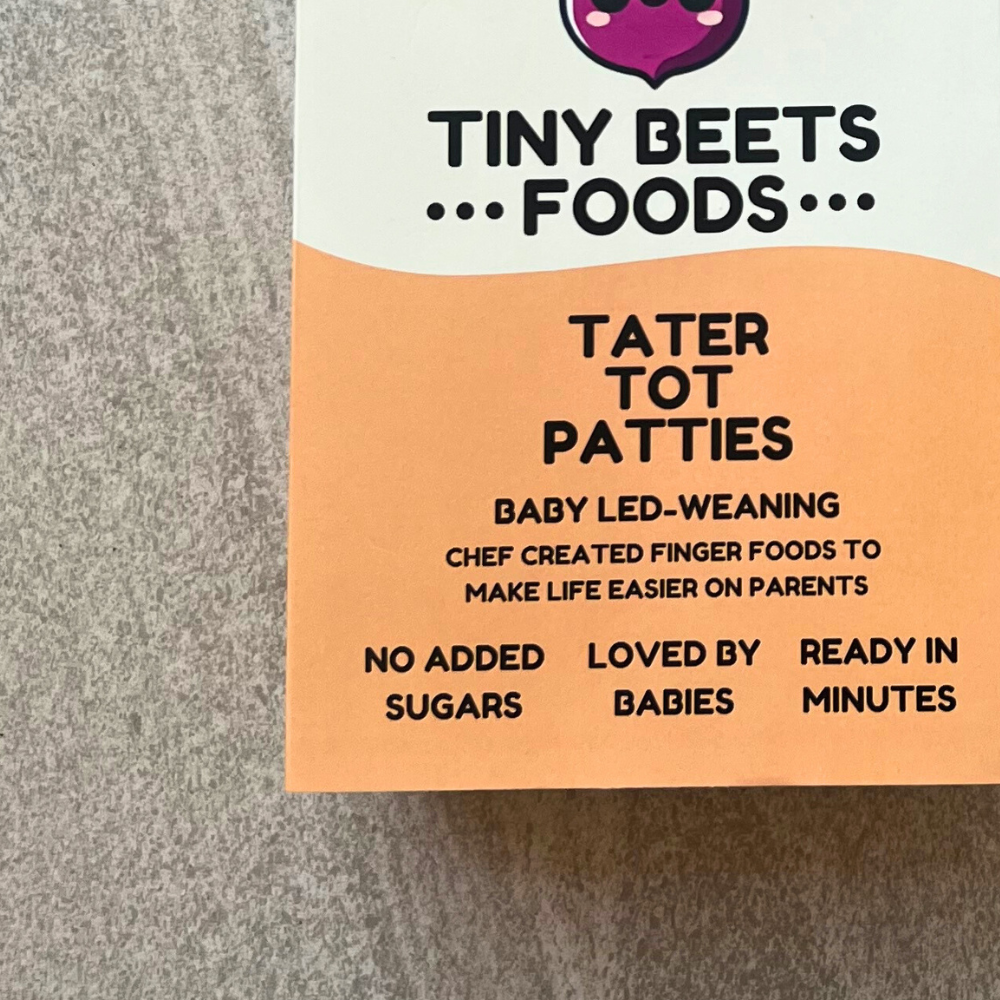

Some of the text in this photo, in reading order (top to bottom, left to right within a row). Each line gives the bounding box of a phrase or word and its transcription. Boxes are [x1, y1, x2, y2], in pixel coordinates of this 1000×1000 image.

[427, 104, 881, 168] TINY BEETS
[523, 174, 789, 237] FOODS
[567, 311, 770, 359] TATER
[604, 364, 734, 411] TOT
[543, 415, 794, 465] PATTIES
[494, 491, 840, 525] BABY LED-WEANING
[445, 538, 882, 568] CHEF CREATED FINGER FOODS TO
[465, 574, 869, 604] MAKE LIFE EASIER ON PARENTS
[364, 643, 545, 674] NO ADDED
[587, 638, 761, 670] LOVED BY
[800, 636, 958, 666] READY IN
[385, 691, 523, 721] SUGARS
[613, 687, 735, 717] BABIES
[802, 684, 957, 714] MINUTES
